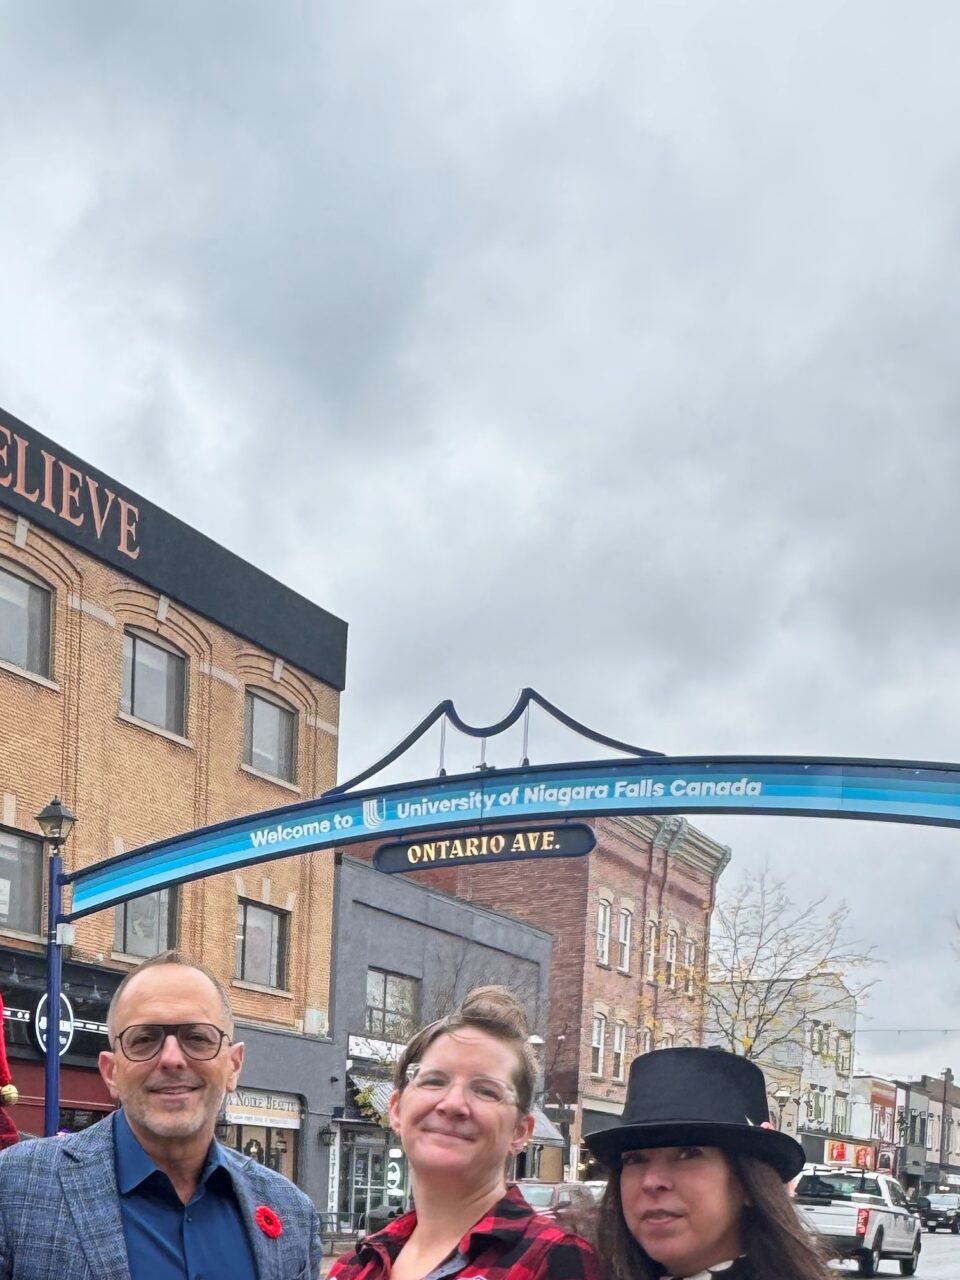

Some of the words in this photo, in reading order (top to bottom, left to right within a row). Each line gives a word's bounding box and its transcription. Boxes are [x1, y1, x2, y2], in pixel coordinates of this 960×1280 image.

[397, 791, 493, 819] University
[499, 787, 519, 806] of
[524, 784, 609, 806] Niagara
[614, 779, 664, 798] Falls
[670, 777, 762, 797] Canada
[250, 819, 331, 849] Welcome
[333, 812, 354, 830] to
[407, 835, 505, 864] ONTARIO
[511, 831, 561, 852] AVE.
